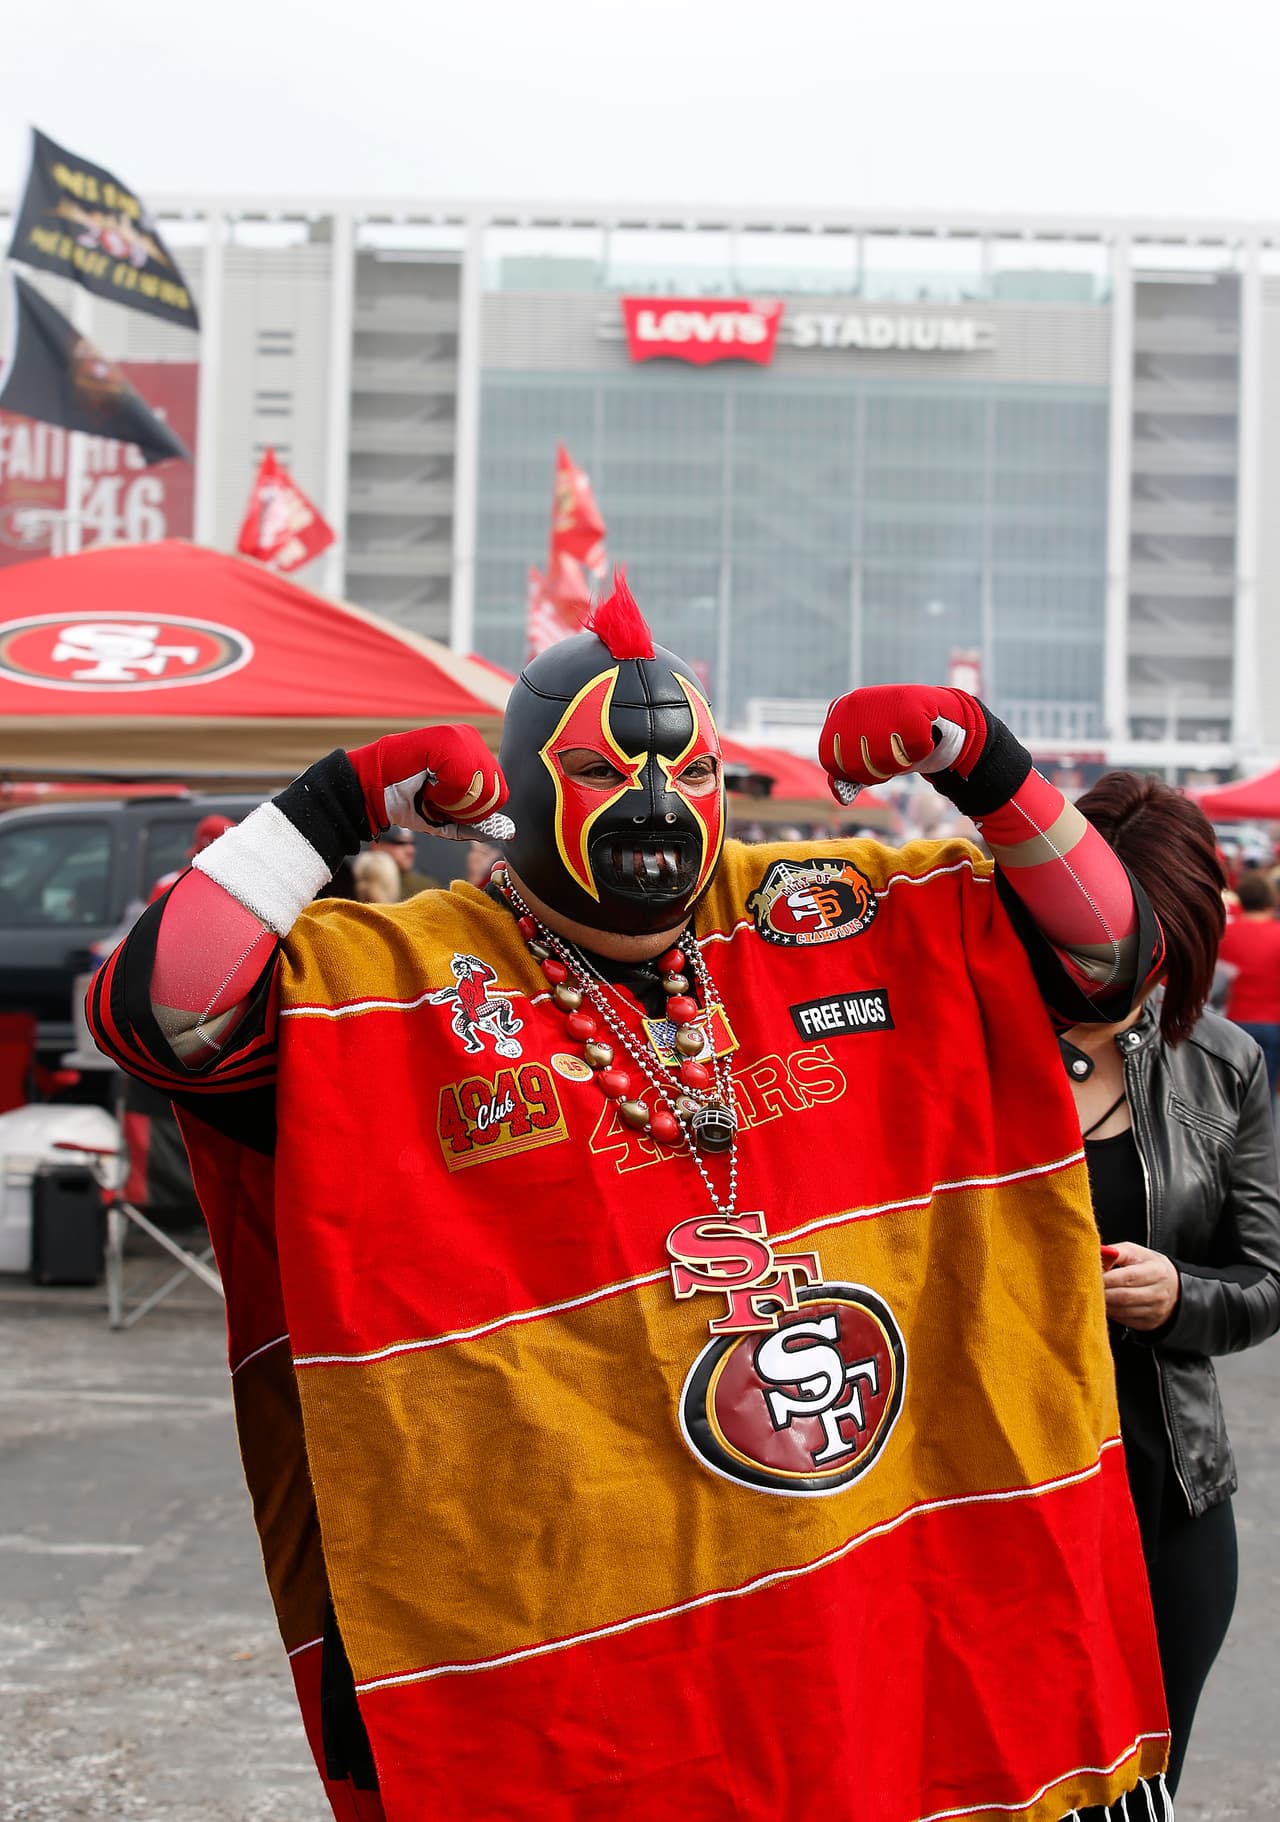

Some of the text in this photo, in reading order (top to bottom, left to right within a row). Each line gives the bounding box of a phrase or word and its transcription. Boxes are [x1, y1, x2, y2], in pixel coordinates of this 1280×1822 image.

[790, 313, 977, 350] STADIUM
[52, 623, 199, 681] SF
[781, 874, 831, 897] CITY OF
[796, 917, 864, 945] CHAMPIONS
[799, 996, 887, 1034] FREE HUGS
[439, 1065, 560, 1154] 4949
[477, 1090, 516, 1131] Club
[588, 1045, 847, 1175] 4RS
[666, 1211, 824, 1335] SF
[754, 1311, 880, 1466] SF
